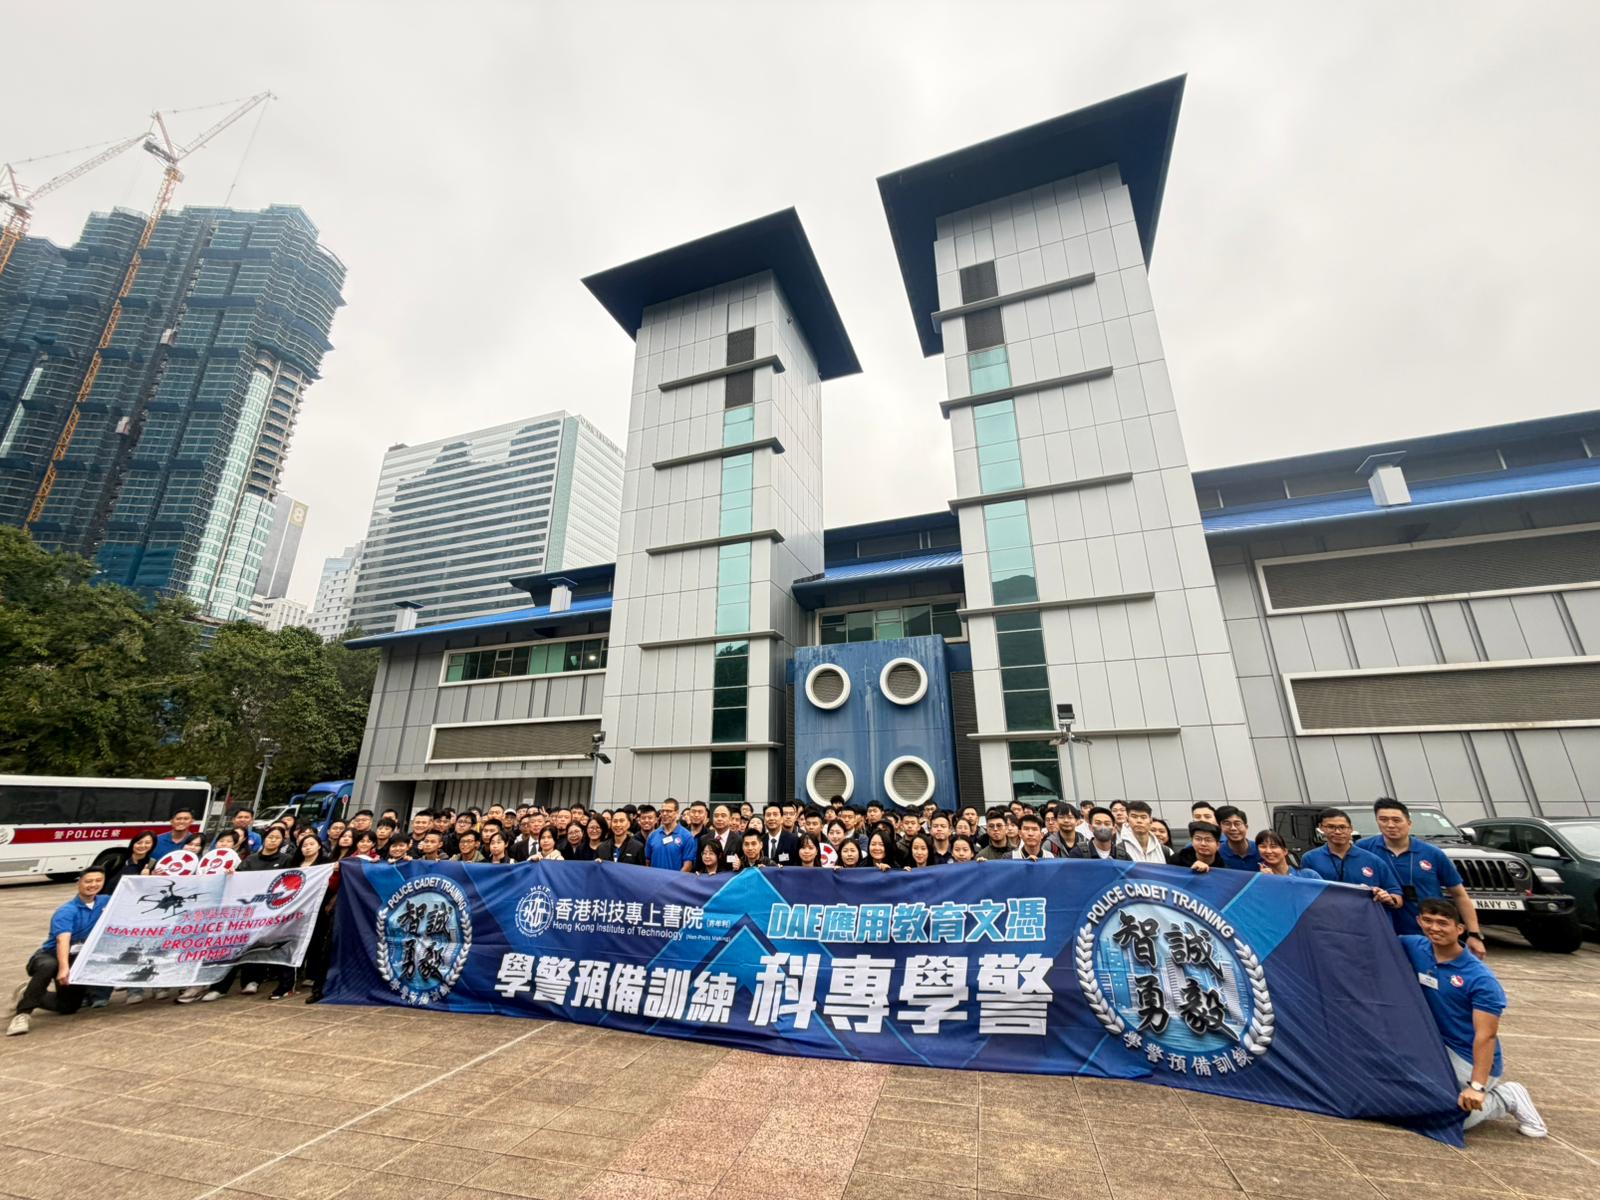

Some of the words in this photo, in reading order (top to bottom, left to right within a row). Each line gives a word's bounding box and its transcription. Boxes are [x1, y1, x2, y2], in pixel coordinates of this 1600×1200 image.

[66, 829, 109, 839] POLICE
[388, 882, 414, 908] POLICE
[414, 877, 440, 890] CADET
[441, 879, 467, 910] TRAINING
[1477, 901, 1502, 909] NAVY
[1506, 901, 1518, 910] 19
[555, 898, 704, 930] 香港科技專上書院
[1087, 887, 1126, 924] POLICE
[1124, 883, 1168, 901] CADET
[1171, 890, 1235, 939] TRAINING
[105, 926, 168, 937] MARINE
[172, 921, 223, 935] POLICE
[162, 933, 250, 950] PROGRAMME
[553, 921, 572, 932] Hong
[575, 922, 594, 933] Kong
[597, 923, 625, 934] Institute
[627, 926, 635, 935] of
[637, 926, 683, 941] Technology
[494, 952, 737, 1023] 學警預備訓練
[748, 952, 1054, 1036] 科專學警
